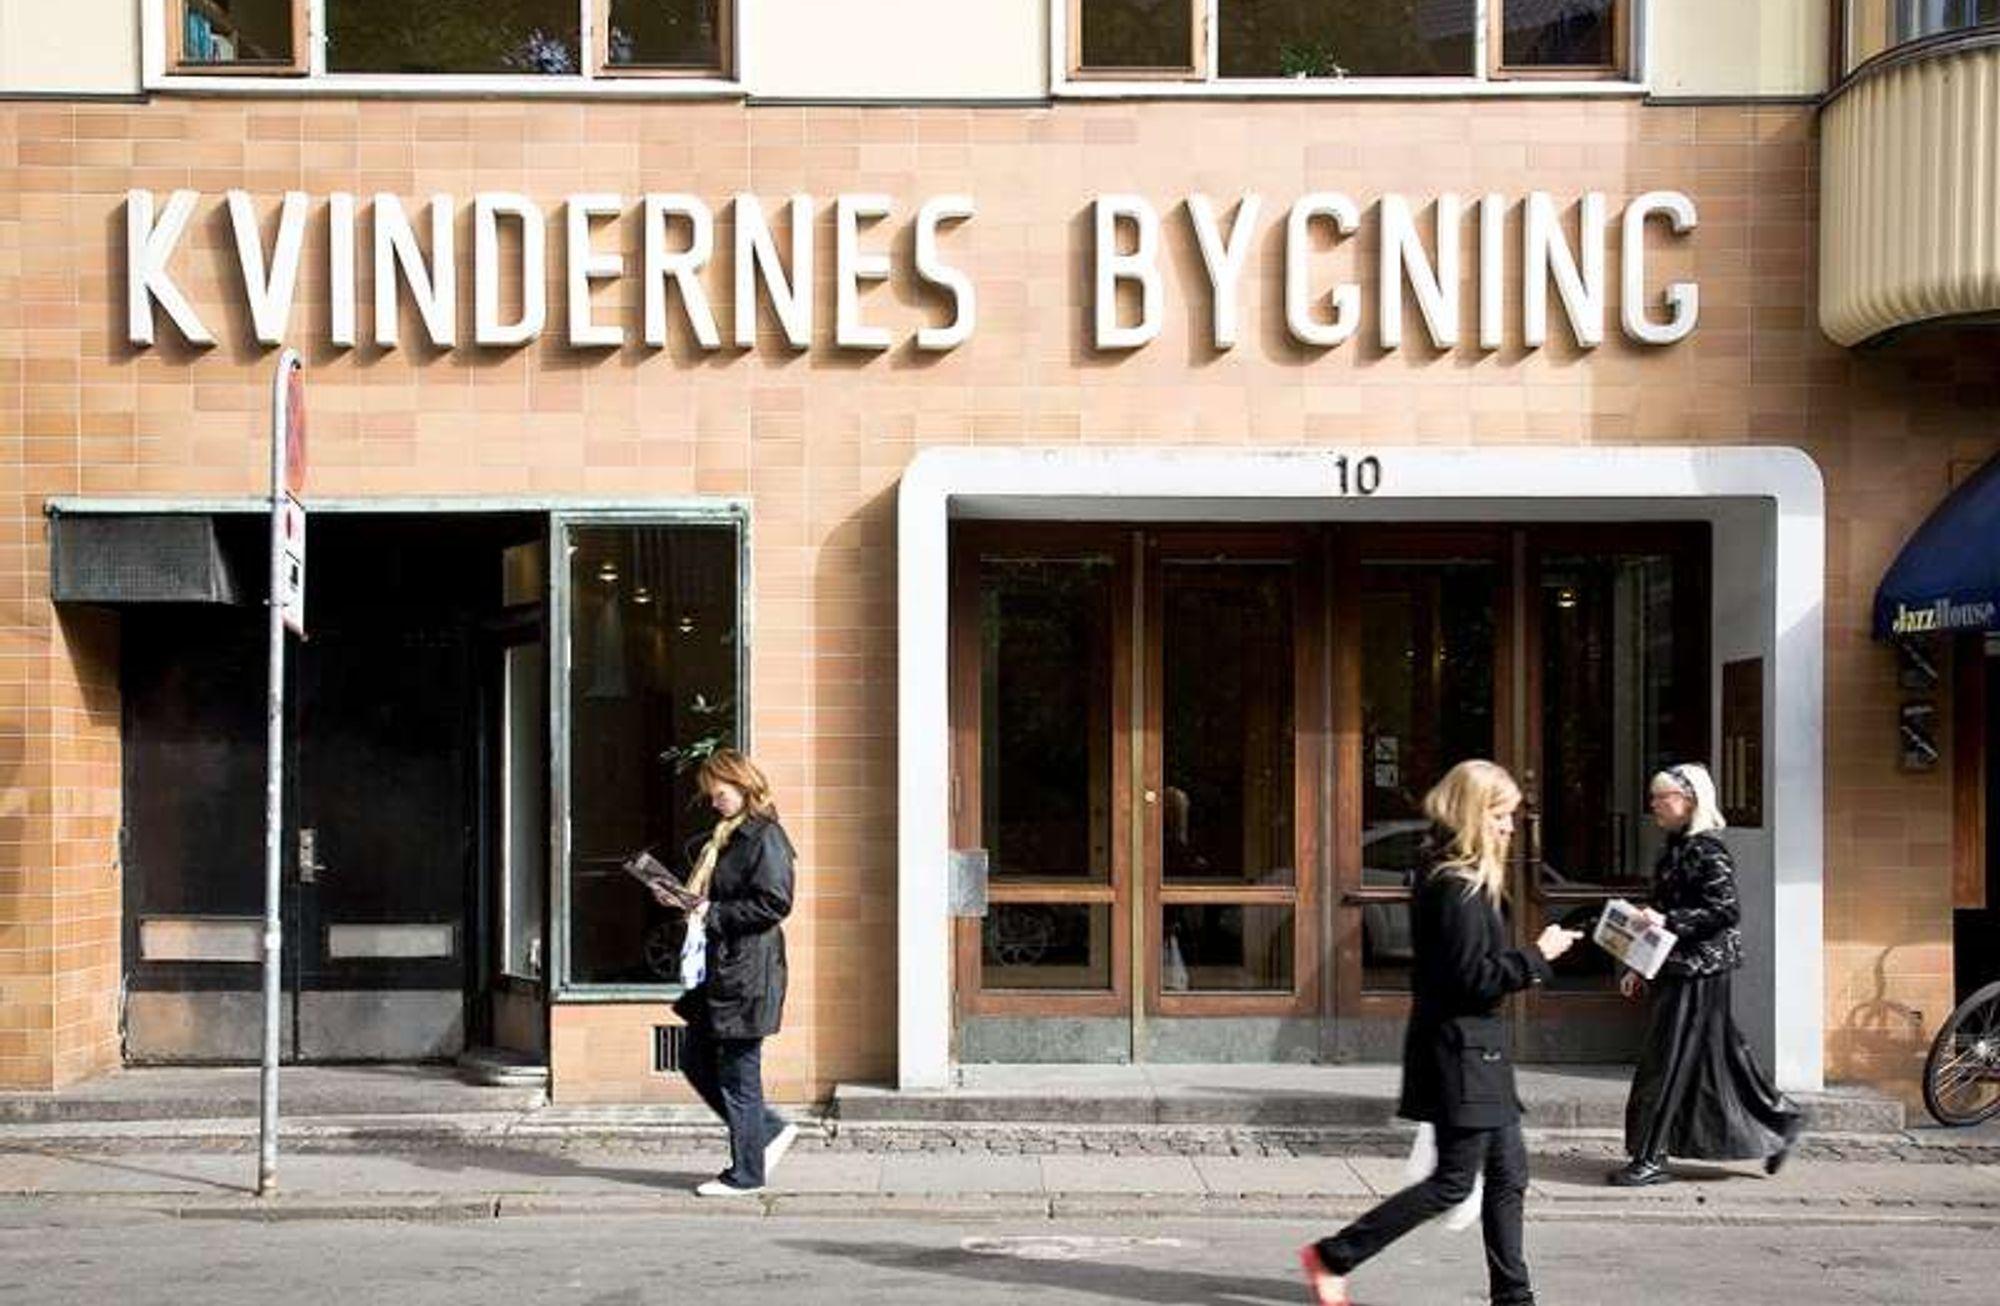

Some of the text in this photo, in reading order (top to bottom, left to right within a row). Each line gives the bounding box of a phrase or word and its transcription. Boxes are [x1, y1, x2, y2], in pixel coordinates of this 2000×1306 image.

[127, 189, 1699, 348] KVINDERNES BYGNING
[1334, 456, 1381, 496] 10
